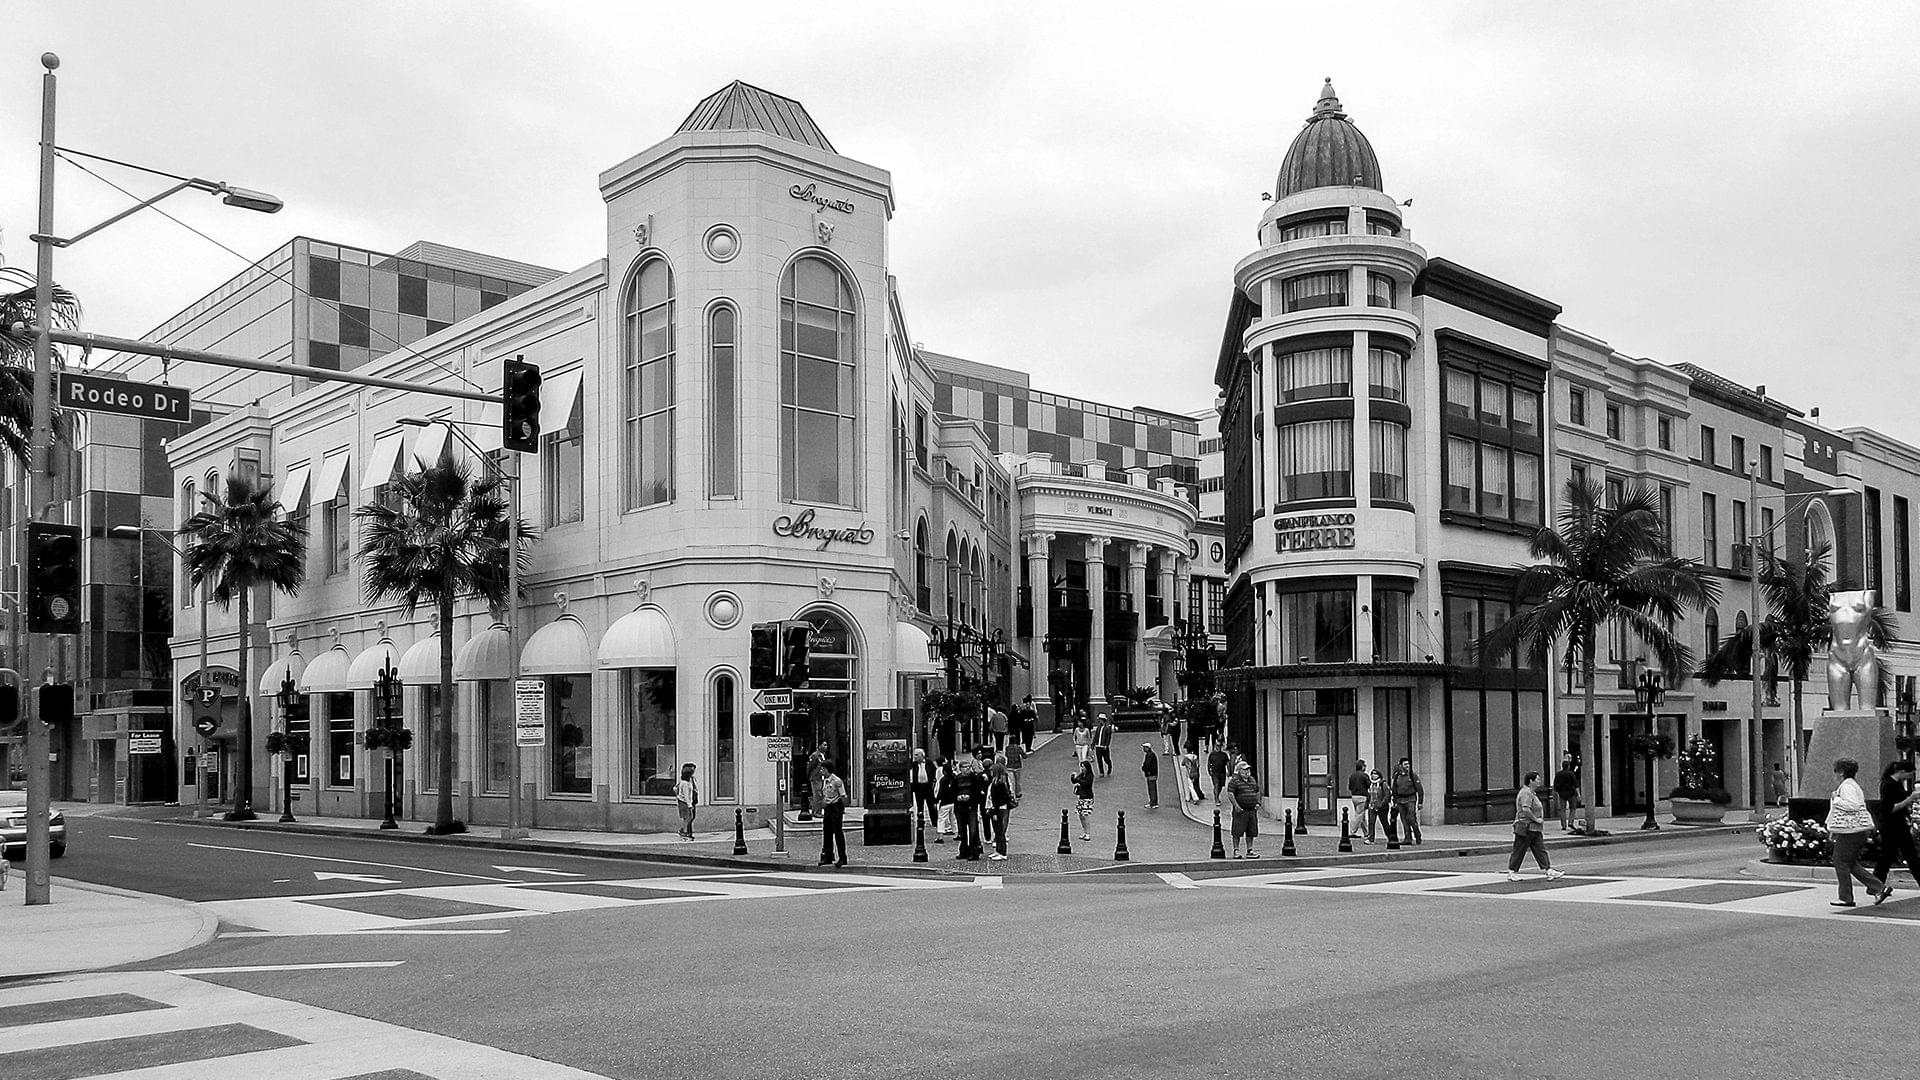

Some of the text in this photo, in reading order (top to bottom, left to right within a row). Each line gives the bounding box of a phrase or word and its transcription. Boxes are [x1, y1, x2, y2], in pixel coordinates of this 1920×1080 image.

[788, 182, 855, 215] Breguet
[71, 382, 180, 413] Rodeo Dr
[1273, 513, 1356, 531] GIANFRANCO
[773, 508, 875, 552] Breguet
[202, 689, 215, 702] P
[764, 695, 789, 704] ONE WAY
[767, 750, 778, 760] OK
[876, 779, 904, 788] parking
